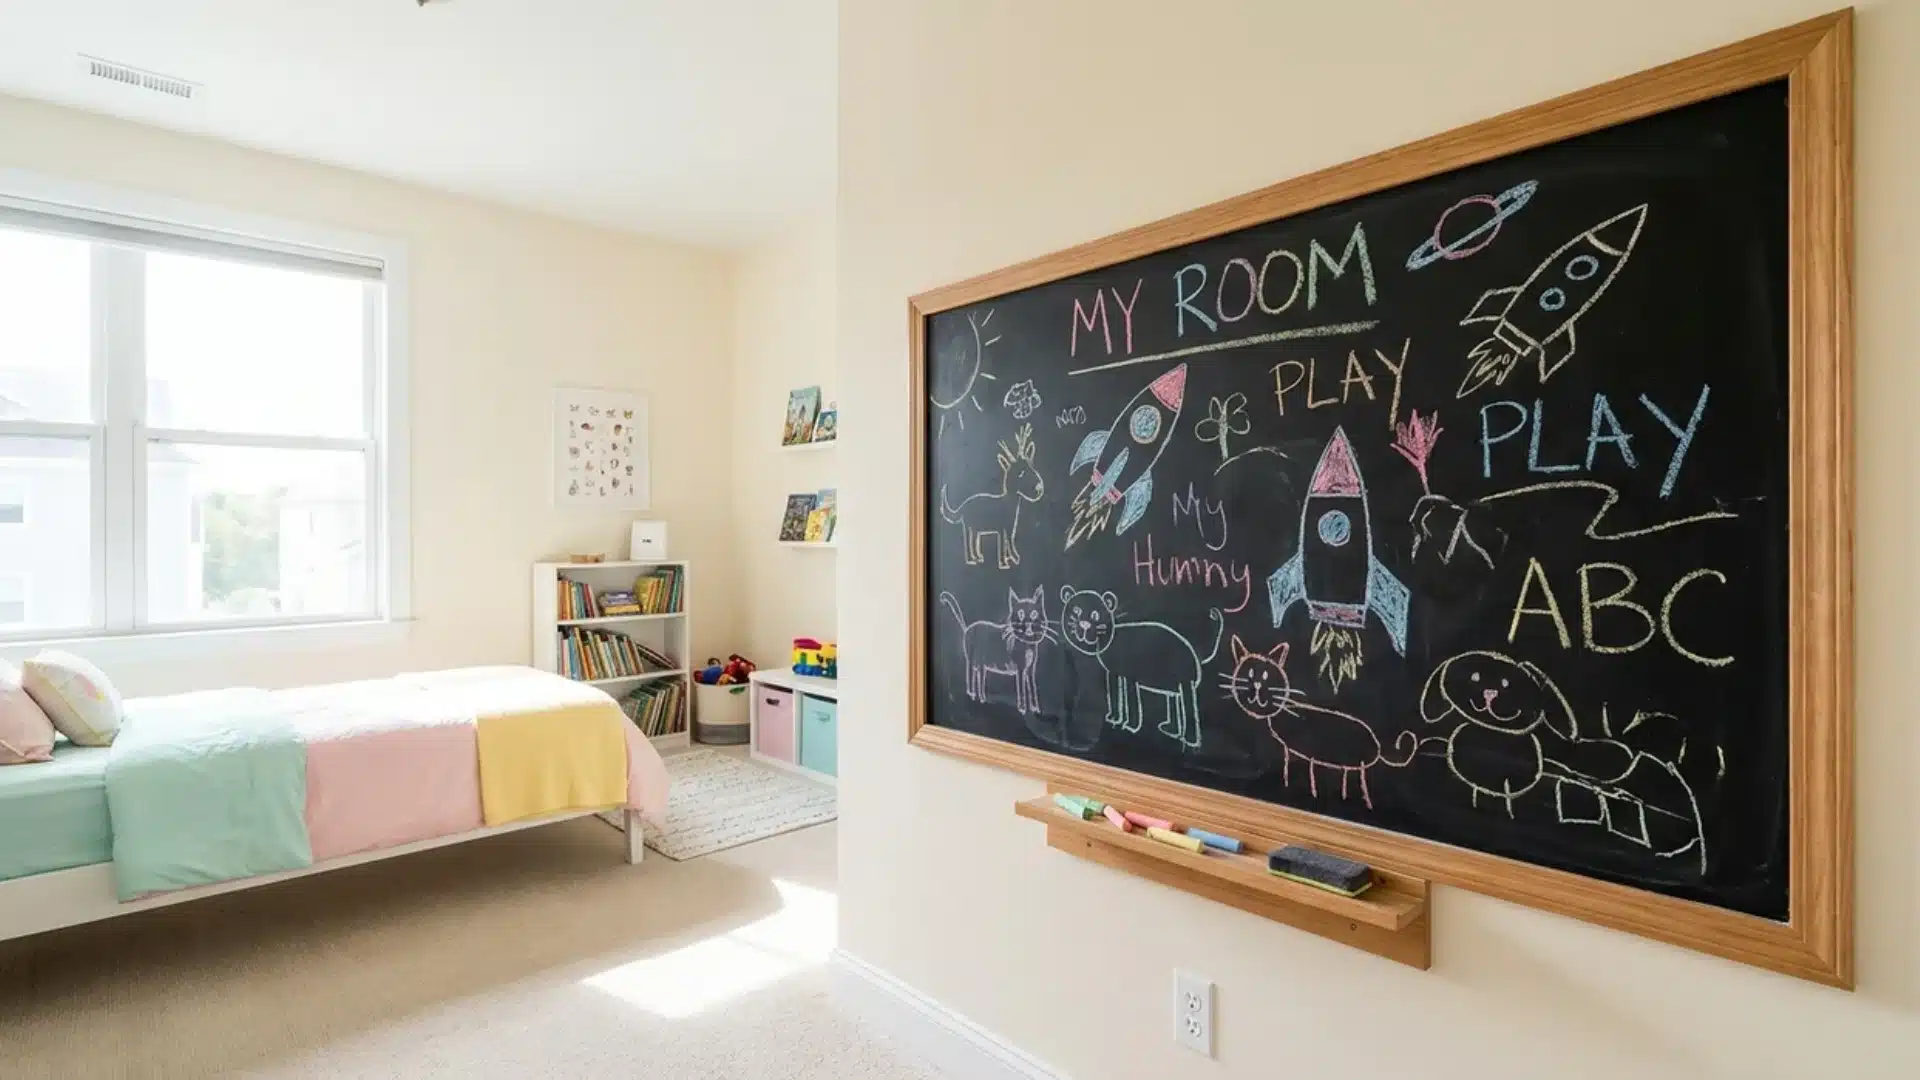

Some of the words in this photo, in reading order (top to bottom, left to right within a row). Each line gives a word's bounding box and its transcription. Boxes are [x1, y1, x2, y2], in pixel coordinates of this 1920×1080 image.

[1070, 277, 1144, 357] MY
[1173, 221, 1378, 337] ROOM
[1269, 337, 1412, 432] PLAY
[1479, 383, 1711, 499] PLAY
[1172, 481, 1227, 551] My
[1506, 556, 1736, 667] ABC
